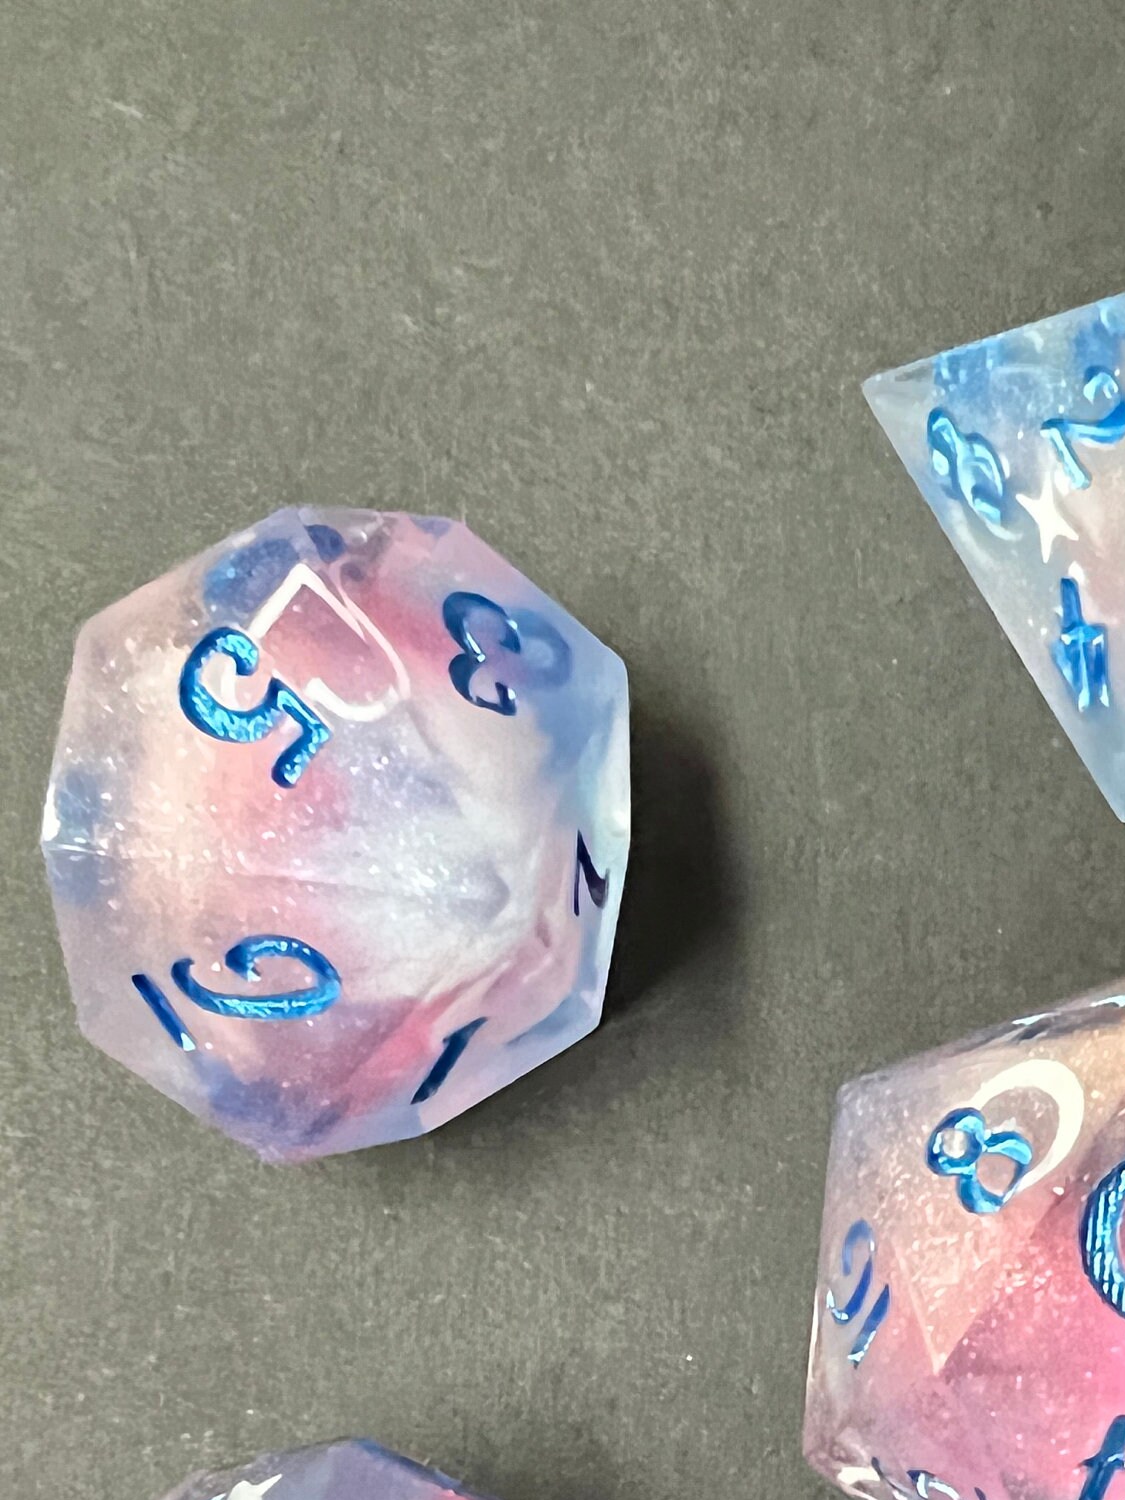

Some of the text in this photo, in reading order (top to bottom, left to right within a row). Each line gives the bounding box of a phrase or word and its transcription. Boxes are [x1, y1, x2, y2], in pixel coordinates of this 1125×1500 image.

[178, 625, 332, 789] 5
[442, 590, 521, 717] 3
[410, 1016, 489, 1106] 1
[925, 1106, 1034, 1214] 8
